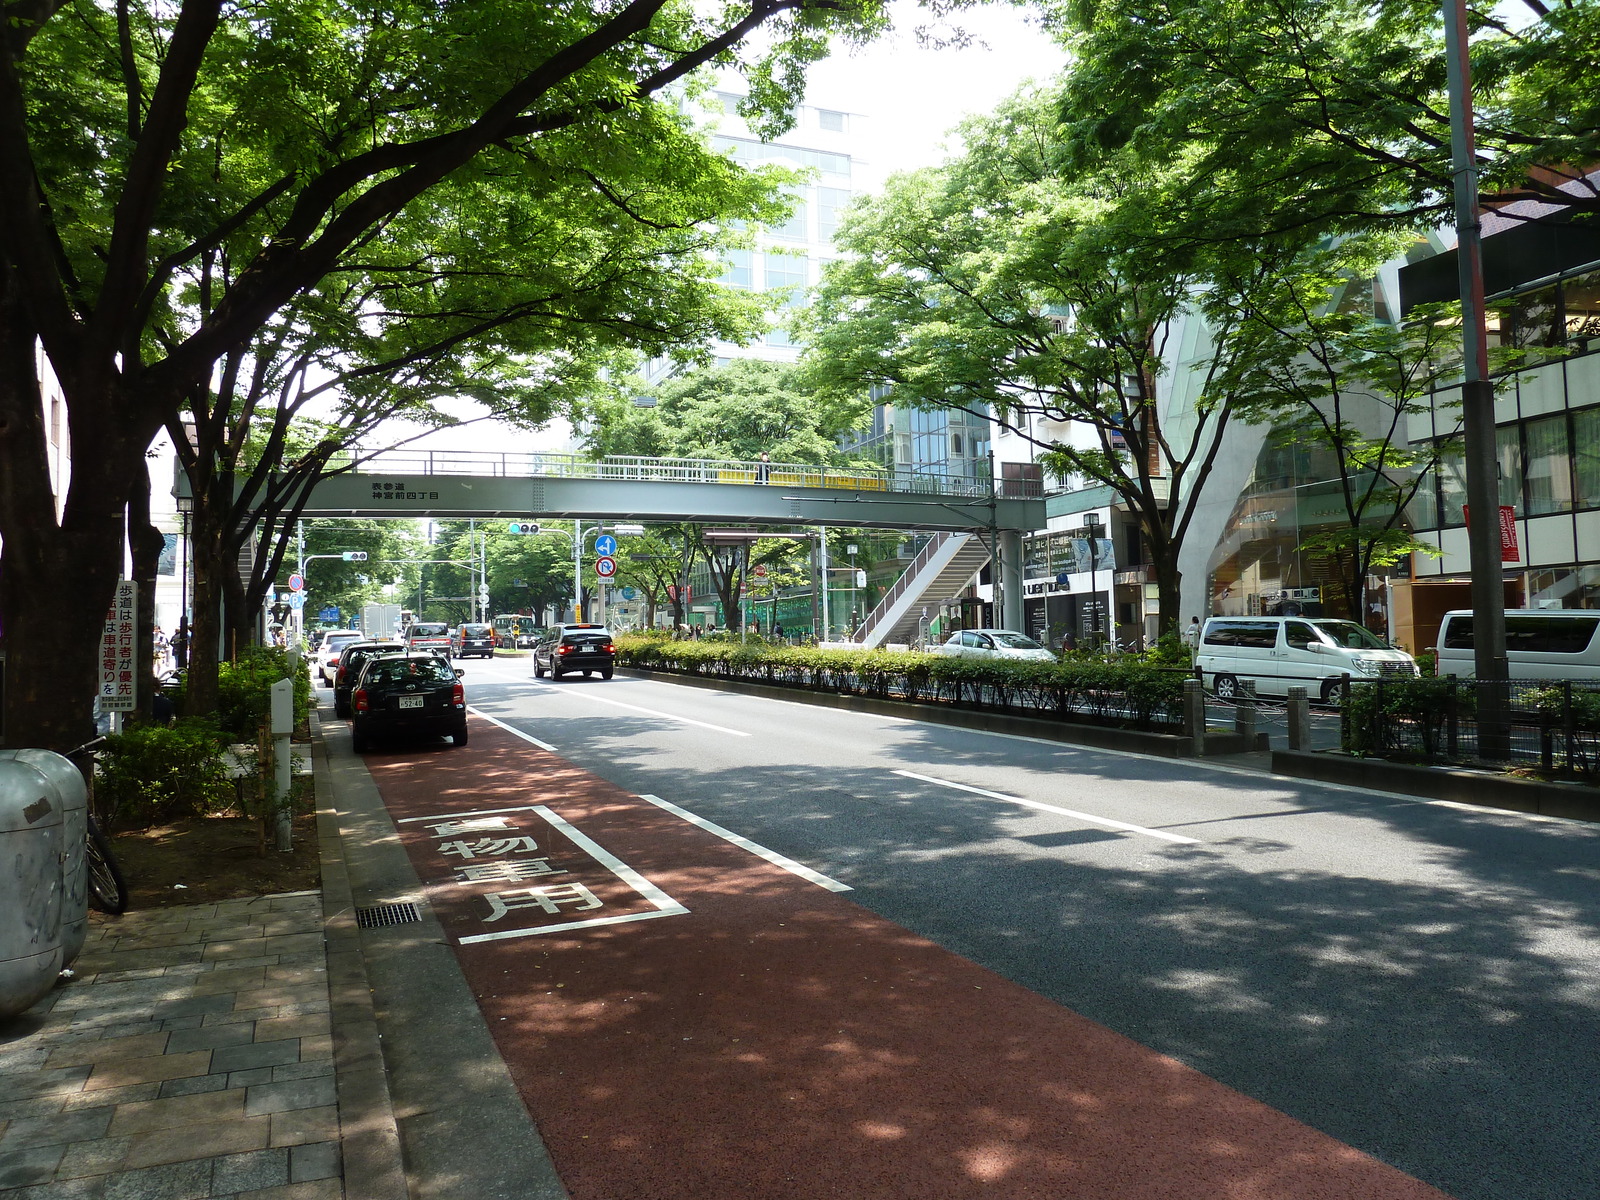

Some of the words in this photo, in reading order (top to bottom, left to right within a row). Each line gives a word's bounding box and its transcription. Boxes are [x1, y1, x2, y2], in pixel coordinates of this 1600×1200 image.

[372, 483, 405, 491] 表参道
[372, 492, 439, 500] 神宮前四丁目
[103, 598, 116, 694] 車は車道寄りを
[118, 585, 132, 695] 歩道は歩行者が優先
